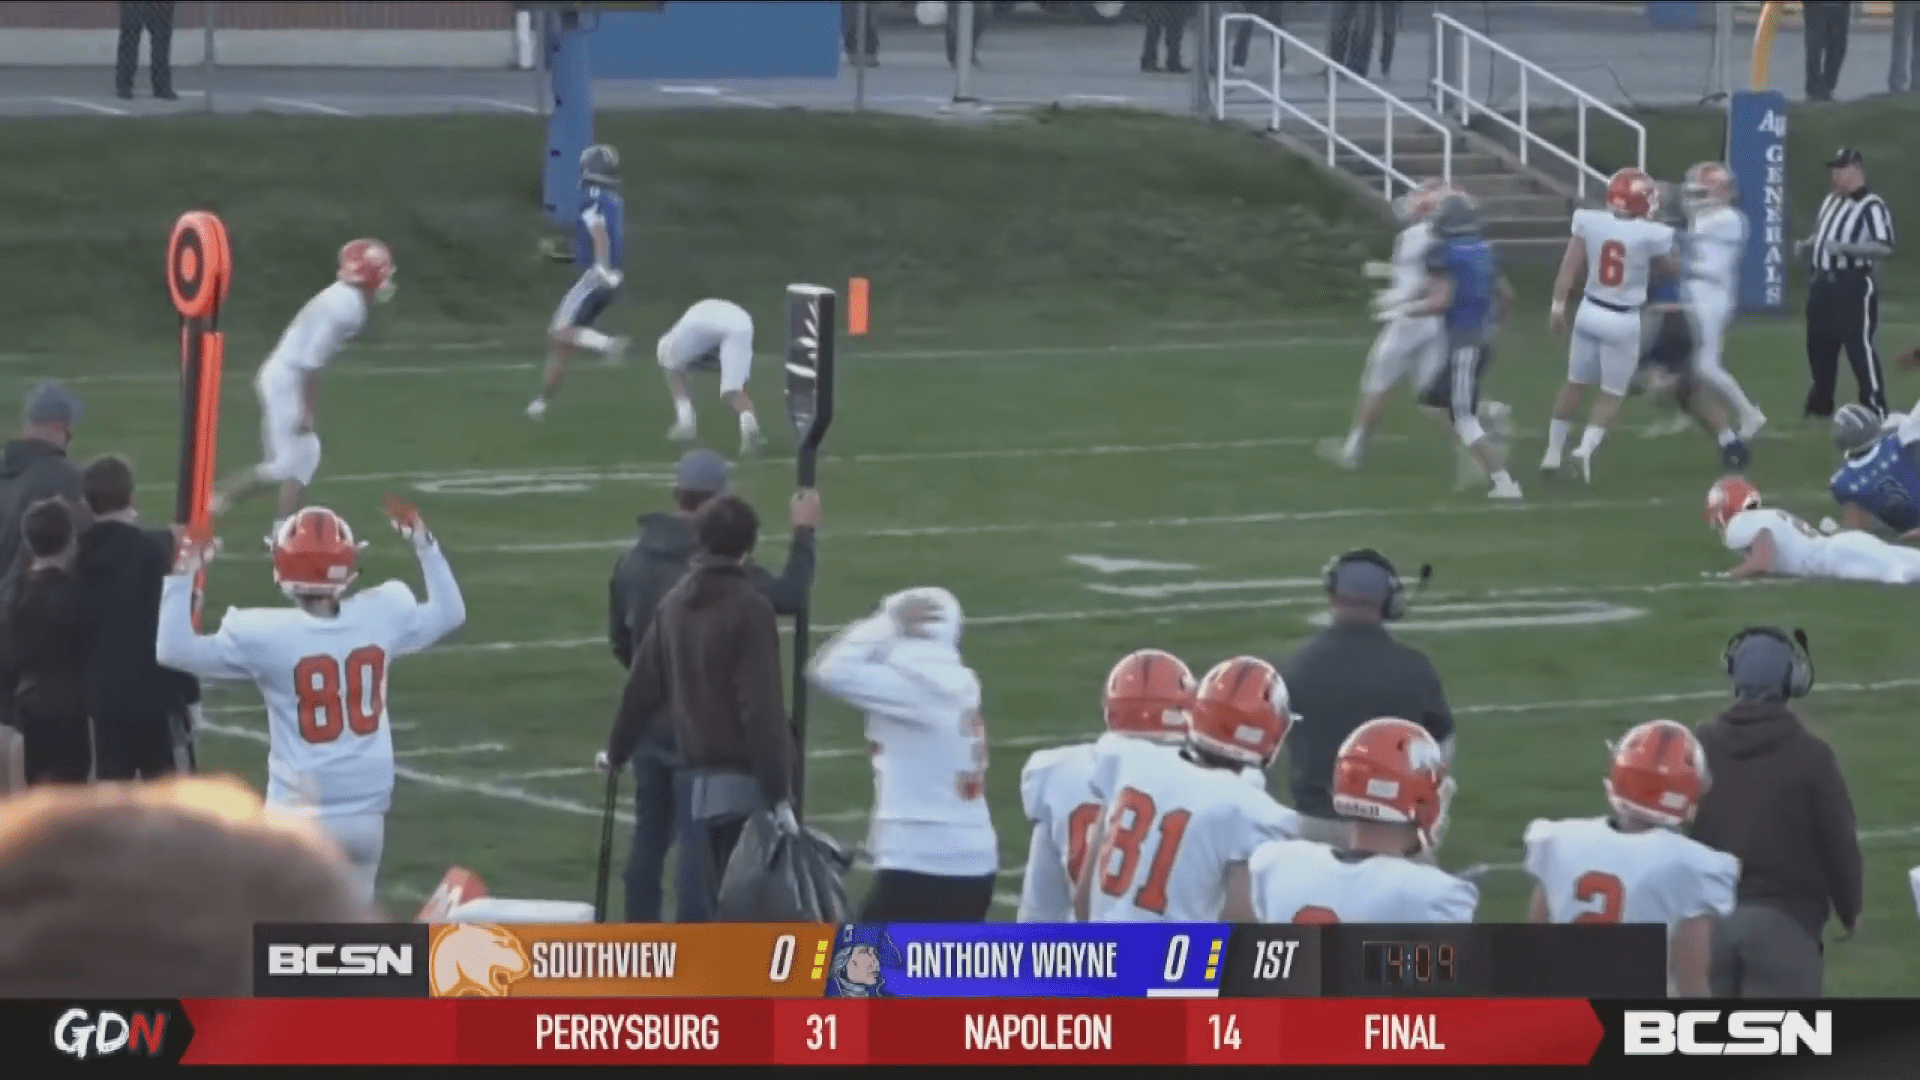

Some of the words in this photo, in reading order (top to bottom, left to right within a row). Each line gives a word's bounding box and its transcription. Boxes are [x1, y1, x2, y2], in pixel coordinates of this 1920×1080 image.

[1600, 239, 1627, 288] 6
[1763, 144, 1784, 305] GENERALS
[293, 643, 385, 744] 80
[1100, 785, 1193, 916] 81
